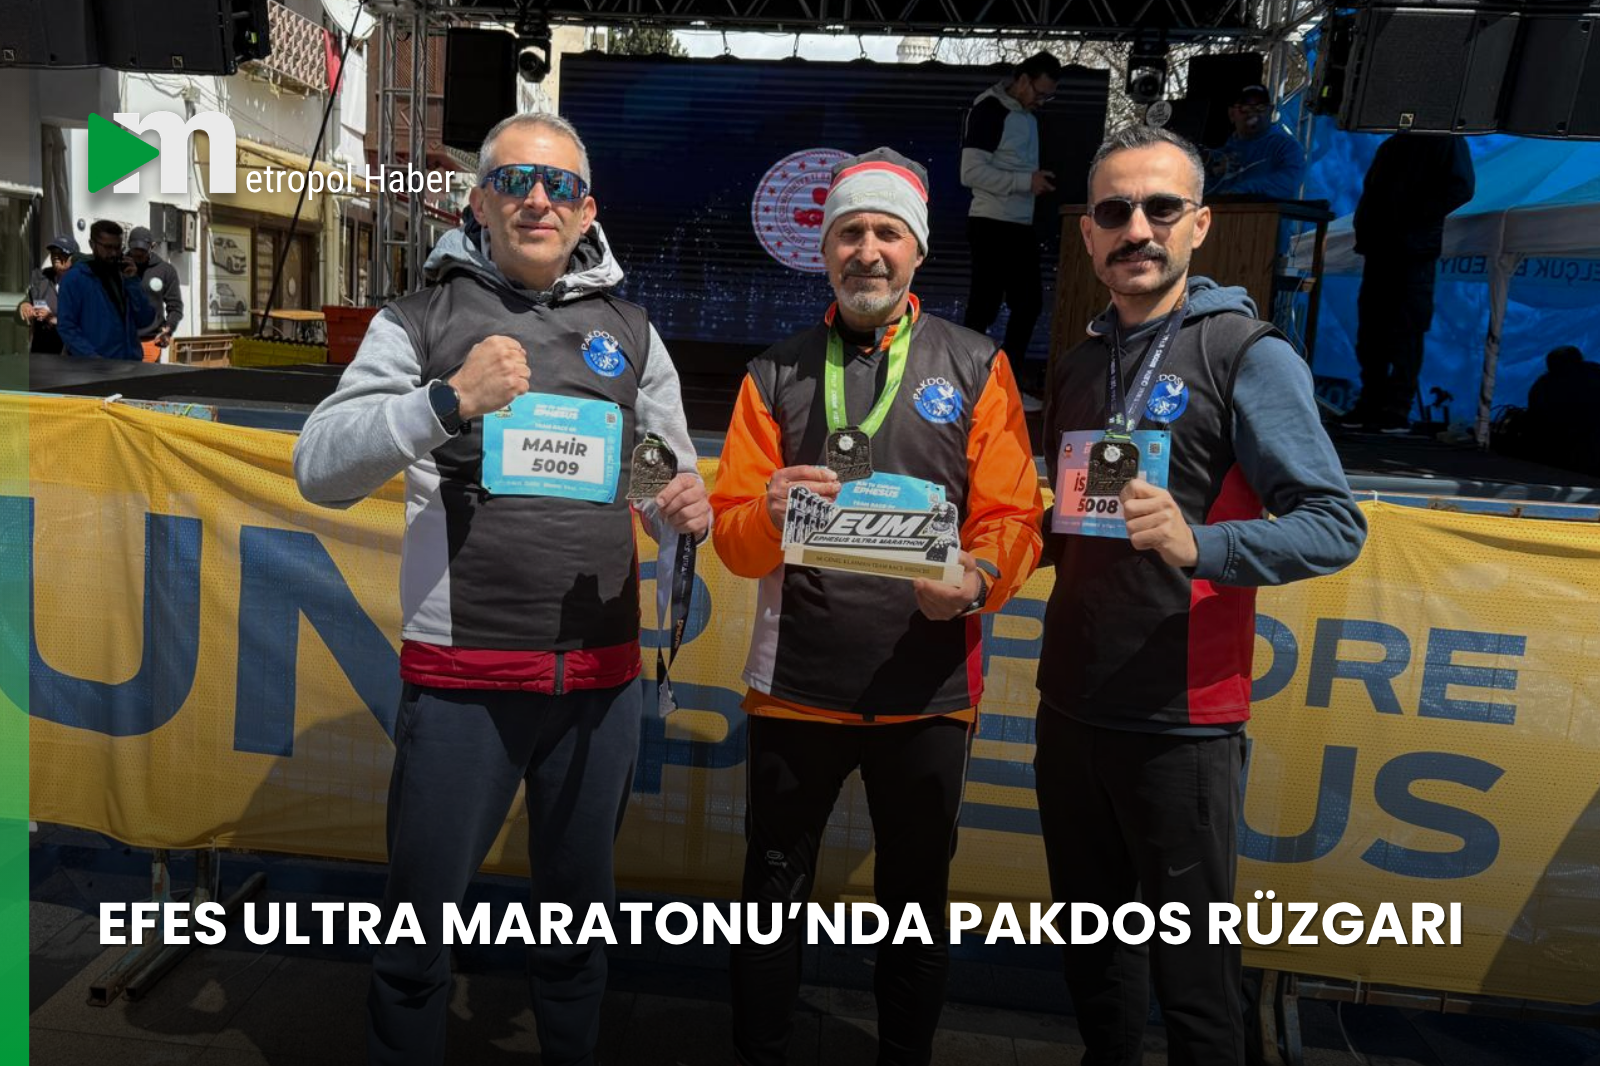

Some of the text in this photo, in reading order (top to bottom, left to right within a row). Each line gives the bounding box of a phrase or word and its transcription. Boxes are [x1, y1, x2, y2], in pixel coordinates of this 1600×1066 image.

[581, 330, 615, 351] PAKDOS
[1156, 374, 1184, 386] DOS
[522, 437, 588, 457] MAHİR
[531, 458, 580, 476] 5009
[1077, 498, 1119, 514] 5008
[826, 512, 927, 537] EUM
[814, 535, 851, 543] EPHESUS
[879, 538, 925, 546] MARATHON
